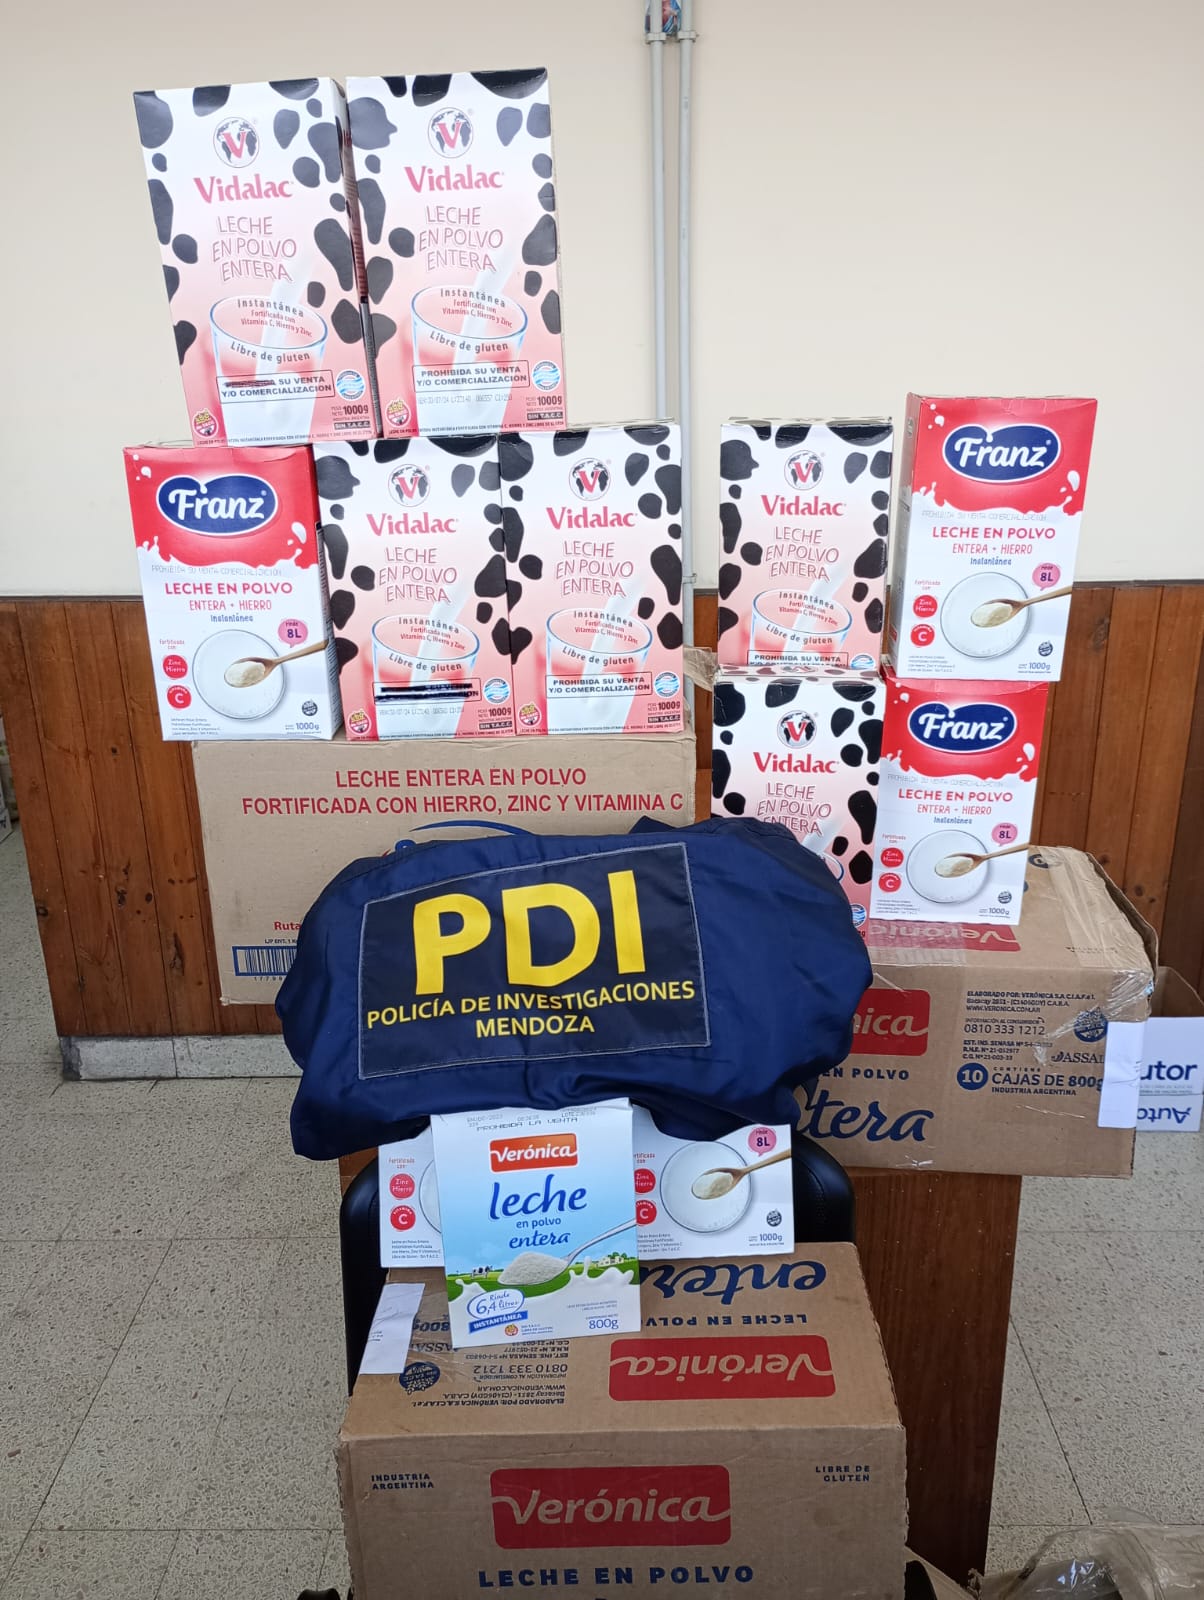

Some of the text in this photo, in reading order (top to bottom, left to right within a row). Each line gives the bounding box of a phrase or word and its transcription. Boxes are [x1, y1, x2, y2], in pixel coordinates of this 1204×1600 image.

[404, 164, 503, 193] Vidalac
[194, 174, 292, 204] Vidalac
[426, 206, 481, 225] LECHE
[218, 216, 272, 235] LECHE
[419, 227, 504, 252] EN POLVO
[212, 238, 296, 262] EN POLVO
[221, 258, 293, 282] ENTERA
[428, 250, 496, 272] ENTERA
[440, 288, 506, 308] Instantánea
[237, 298, 304, 318] Instantánea
[430, 331, 508, 354] Libre de gluten
[230, 341, 310, 364] Libre de gluten
[417, 374, 527, 387] Y/O COMERCIALIZACION
[422, 366, 520, 378] PROHIBIDA SU VENTA
[343, 404, 368, 416] 1000g
[538, 396, 562, 406] 1000g
[954, 436, 1047, 468] Franz
[168, 487, 264, 520] Franz
[761, 494, 844, 516] Vidalac
[366, 512, 456, 536] Vidalac
[546, 506, 636, 530] Vidalac
[775, 526, 823, 544] LECHE
[932, 526, 1056, 539] LECHE EN POLVO
[385, 547, 437, 564] LECHE
[564, 540, 615, 557] LECHE
[765, 544, 839, 563] EN POLVO
[379, 565, 458, 586] EN POLVO
[556, 560, 634, 579] EN POLVO
[770, 562, 830, 582] ENTERA
[164, 582, 292, 595] LECHE EN POLVO
[386, 583, 451, 603] ENTERA
[562, 578, 626, 597] ENTERA
[574, 610, 634, 628] Instantánea
[286, 628, 302, 639] 8L
[562, 646, 634, 667] Libre de gluten
[754, 654, 798, 662] PROHIBIDA
[1029, 662, 1050, 670] 1000g
[553, 678, 600, 686] PROHIBIDA
[174, 692, 184, 704] C
[658, 700, 681, 710] 1000g
[489, 707, 512, 717] 1000g
[296, 722, 320, 730] 1000g
[918, 713, 1005, 740] Franz
[753, 752, 837, 774] Vidalac
[336, 768, 586, 788] LECHE ENTERA EN POLVO
[766, 782, 816, 800] LECHE
[898, 789, 1013, 802] LECHE EN POLVO
[242, 793, 683, 816] FORTIFICADA CON HIERRO, ZINC Y VITAMINA C
[758, 799, 832, 818] EN POLVO
[917, 804, 992, 815] ENTERA HIERRO
[413, 870, 646, 996] PDI
[367, 980, 695, 1030] POLICÍA DE INVESTIGACIONES
[476, 1015, 595, 1038] MENDOZA
[964, 1024, 1045, 1035] 0810 333 1212
[852, 1068, 910, 1080] POLVO
[962, 1070, 984, 1084] 10
[992, 1073, 1040, 1086] CAJAS
[1044, 1074, 1064, 1086] DE
[1140, 1060, 1198, 1081] utor
[1033, 1088, 1076, 1096] ARGENTINA
[1137, 1107, 1192, 1124] Auto
[756, 1136, 770, 1147] 8L
[490, 1144, 578, 1162] Verónica
[490, 1174, 587, 1220] leche
[516, 1217, 562, 1230] en polvo
[509, 1230, 571, 1248] entera
[760, 1233, 782, 1242] 1000g
[476, 1298, 496, 1314] 6,4
[489, 1292, 510, 1302] Rinde
[473, 1312, 522, 1329] INSTANTÁNEA
[588, 1318, 619, 1330] 800g
[641, 1314, 807, 1326] LECHE EN POLV
[473, 1364, 568, 1374] 0810 333 1212
[610, 1353, 833, 1382] Verónica
[371, 1473, 430, 1482] INDUSTRIA
[815, 1465, 850, 1473] LIBRE
[823, 1474, 870, 1482] GLUTEN
[372, 1482, 434, 1490] ARGENTINA
[491, 1488, 731, 1525] Verónica
[478, 1566, 753, 1588] LECHE EN POLVO
